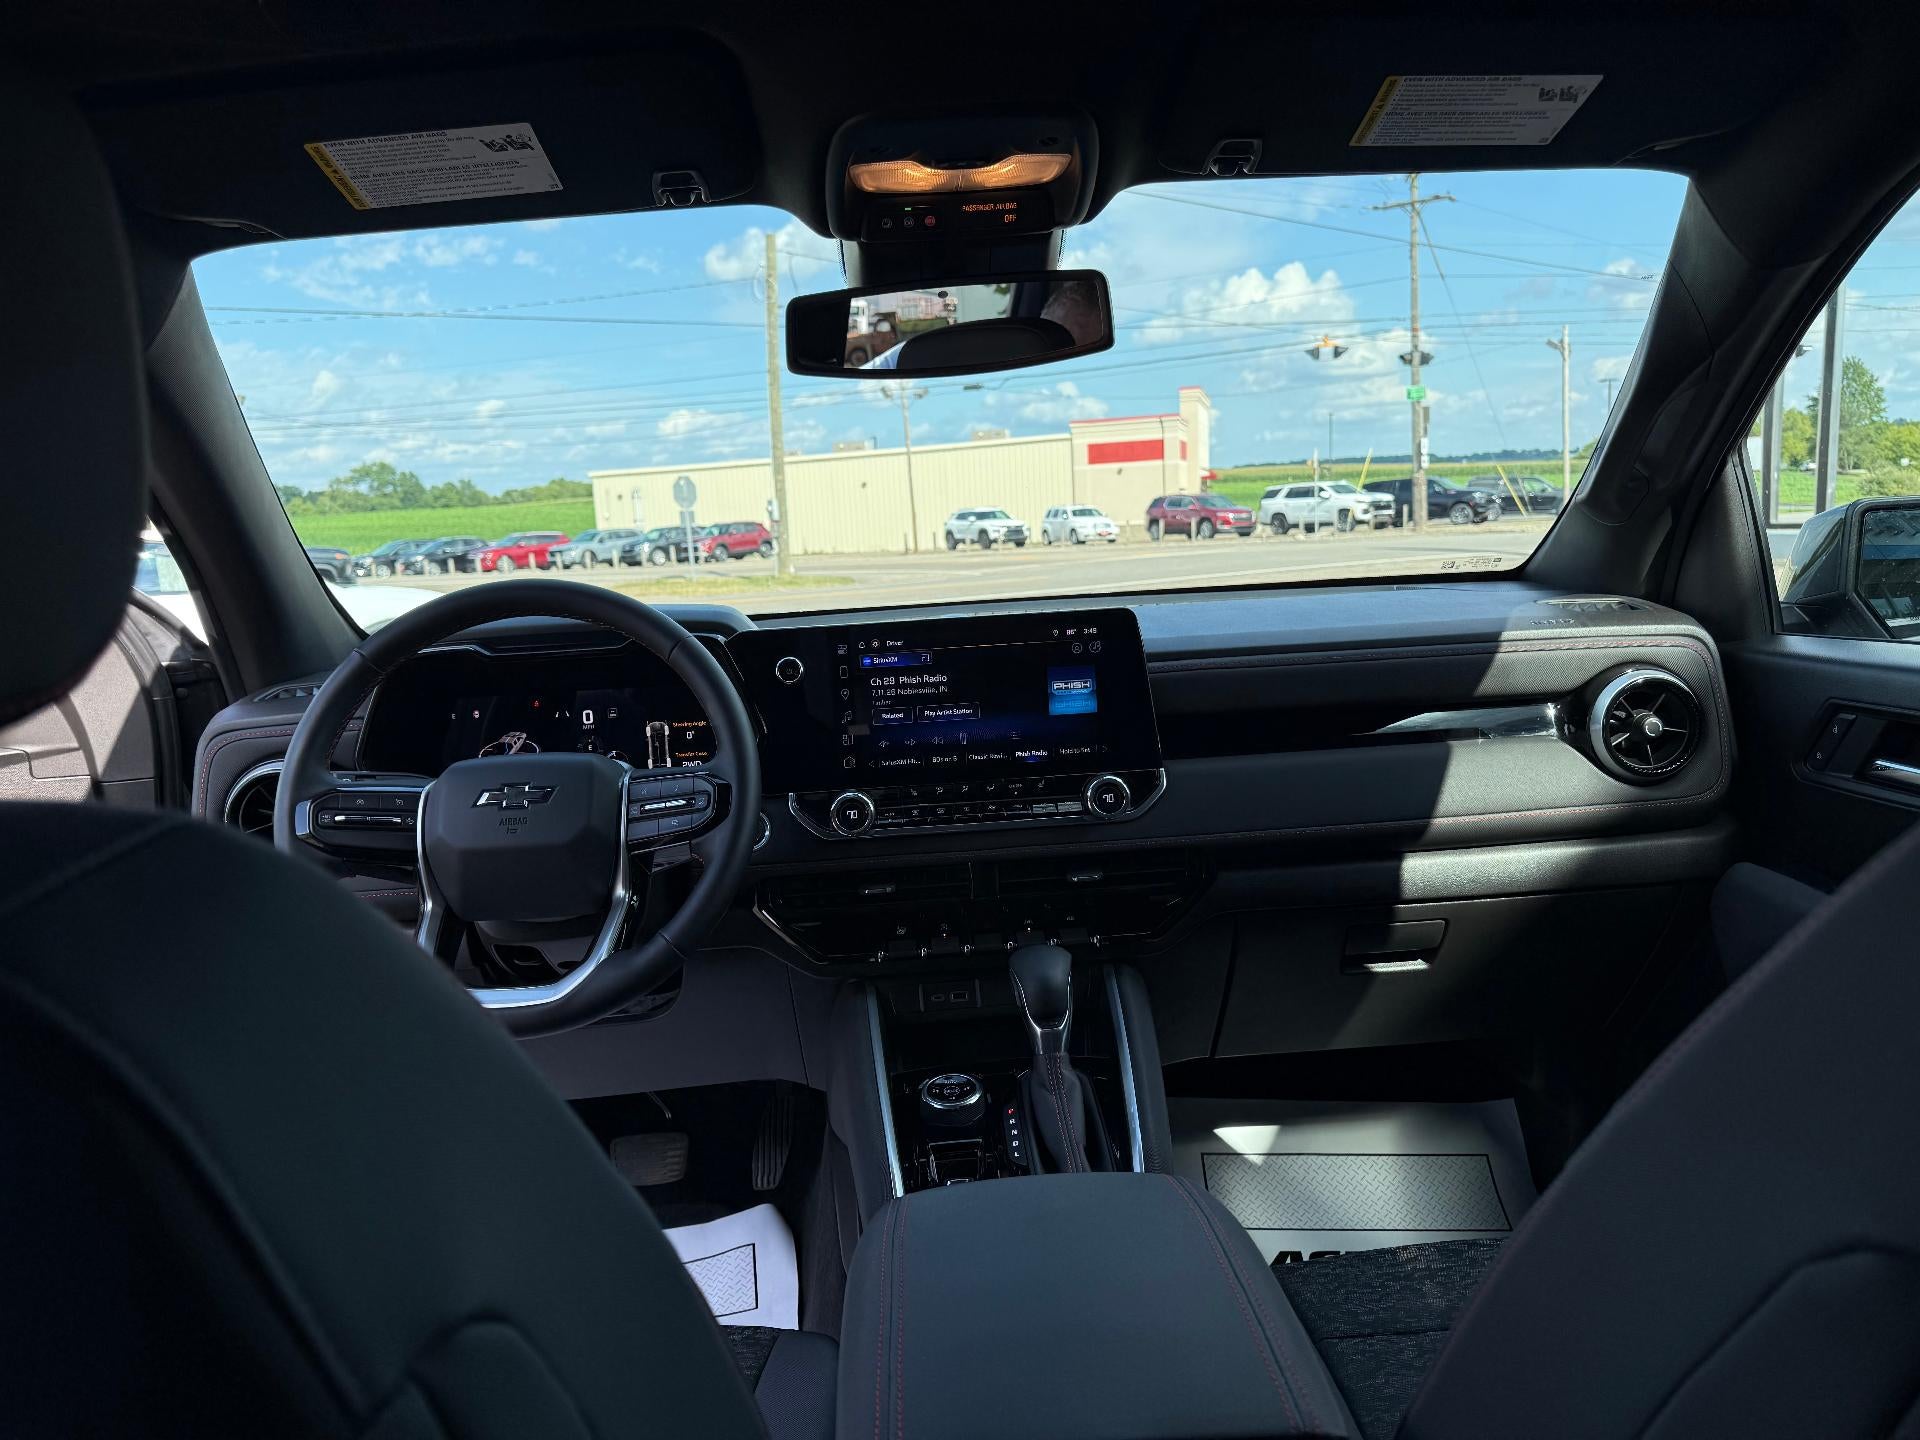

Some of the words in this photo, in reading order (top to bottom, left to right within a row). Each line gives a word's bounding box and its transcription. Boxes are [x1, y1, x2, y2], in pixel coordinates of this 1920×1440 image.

[345, 139, 367, 147] WITH
[368, 135, 409, 145] ADVANCED
[426, 130, 448, 138] BAGS
[962, 203, 994, 212] PASSENGER
[995, 202, 1017, 210] AIRBAG
[1004, 214, 1017, 223] OFF
[873, 656, 898, 664] SiriusXM
[870, 677, 882, 686] Ch
[899, 675, 922, 685] Phish
[923, 674, 948, 683] Radio
[939, 685, 948, 693] IN
[1053, 681, 1090, 690] PHISH
[582, 709, 594, 724] 0
[881, 711, 904, 719] Related
[924, 710, 936, 718] Play
[1015, 750, 1031, 758] Phish
[1031, 749, 1048, 757] Radio
[498, 817, 528, 826] AIRBAG
